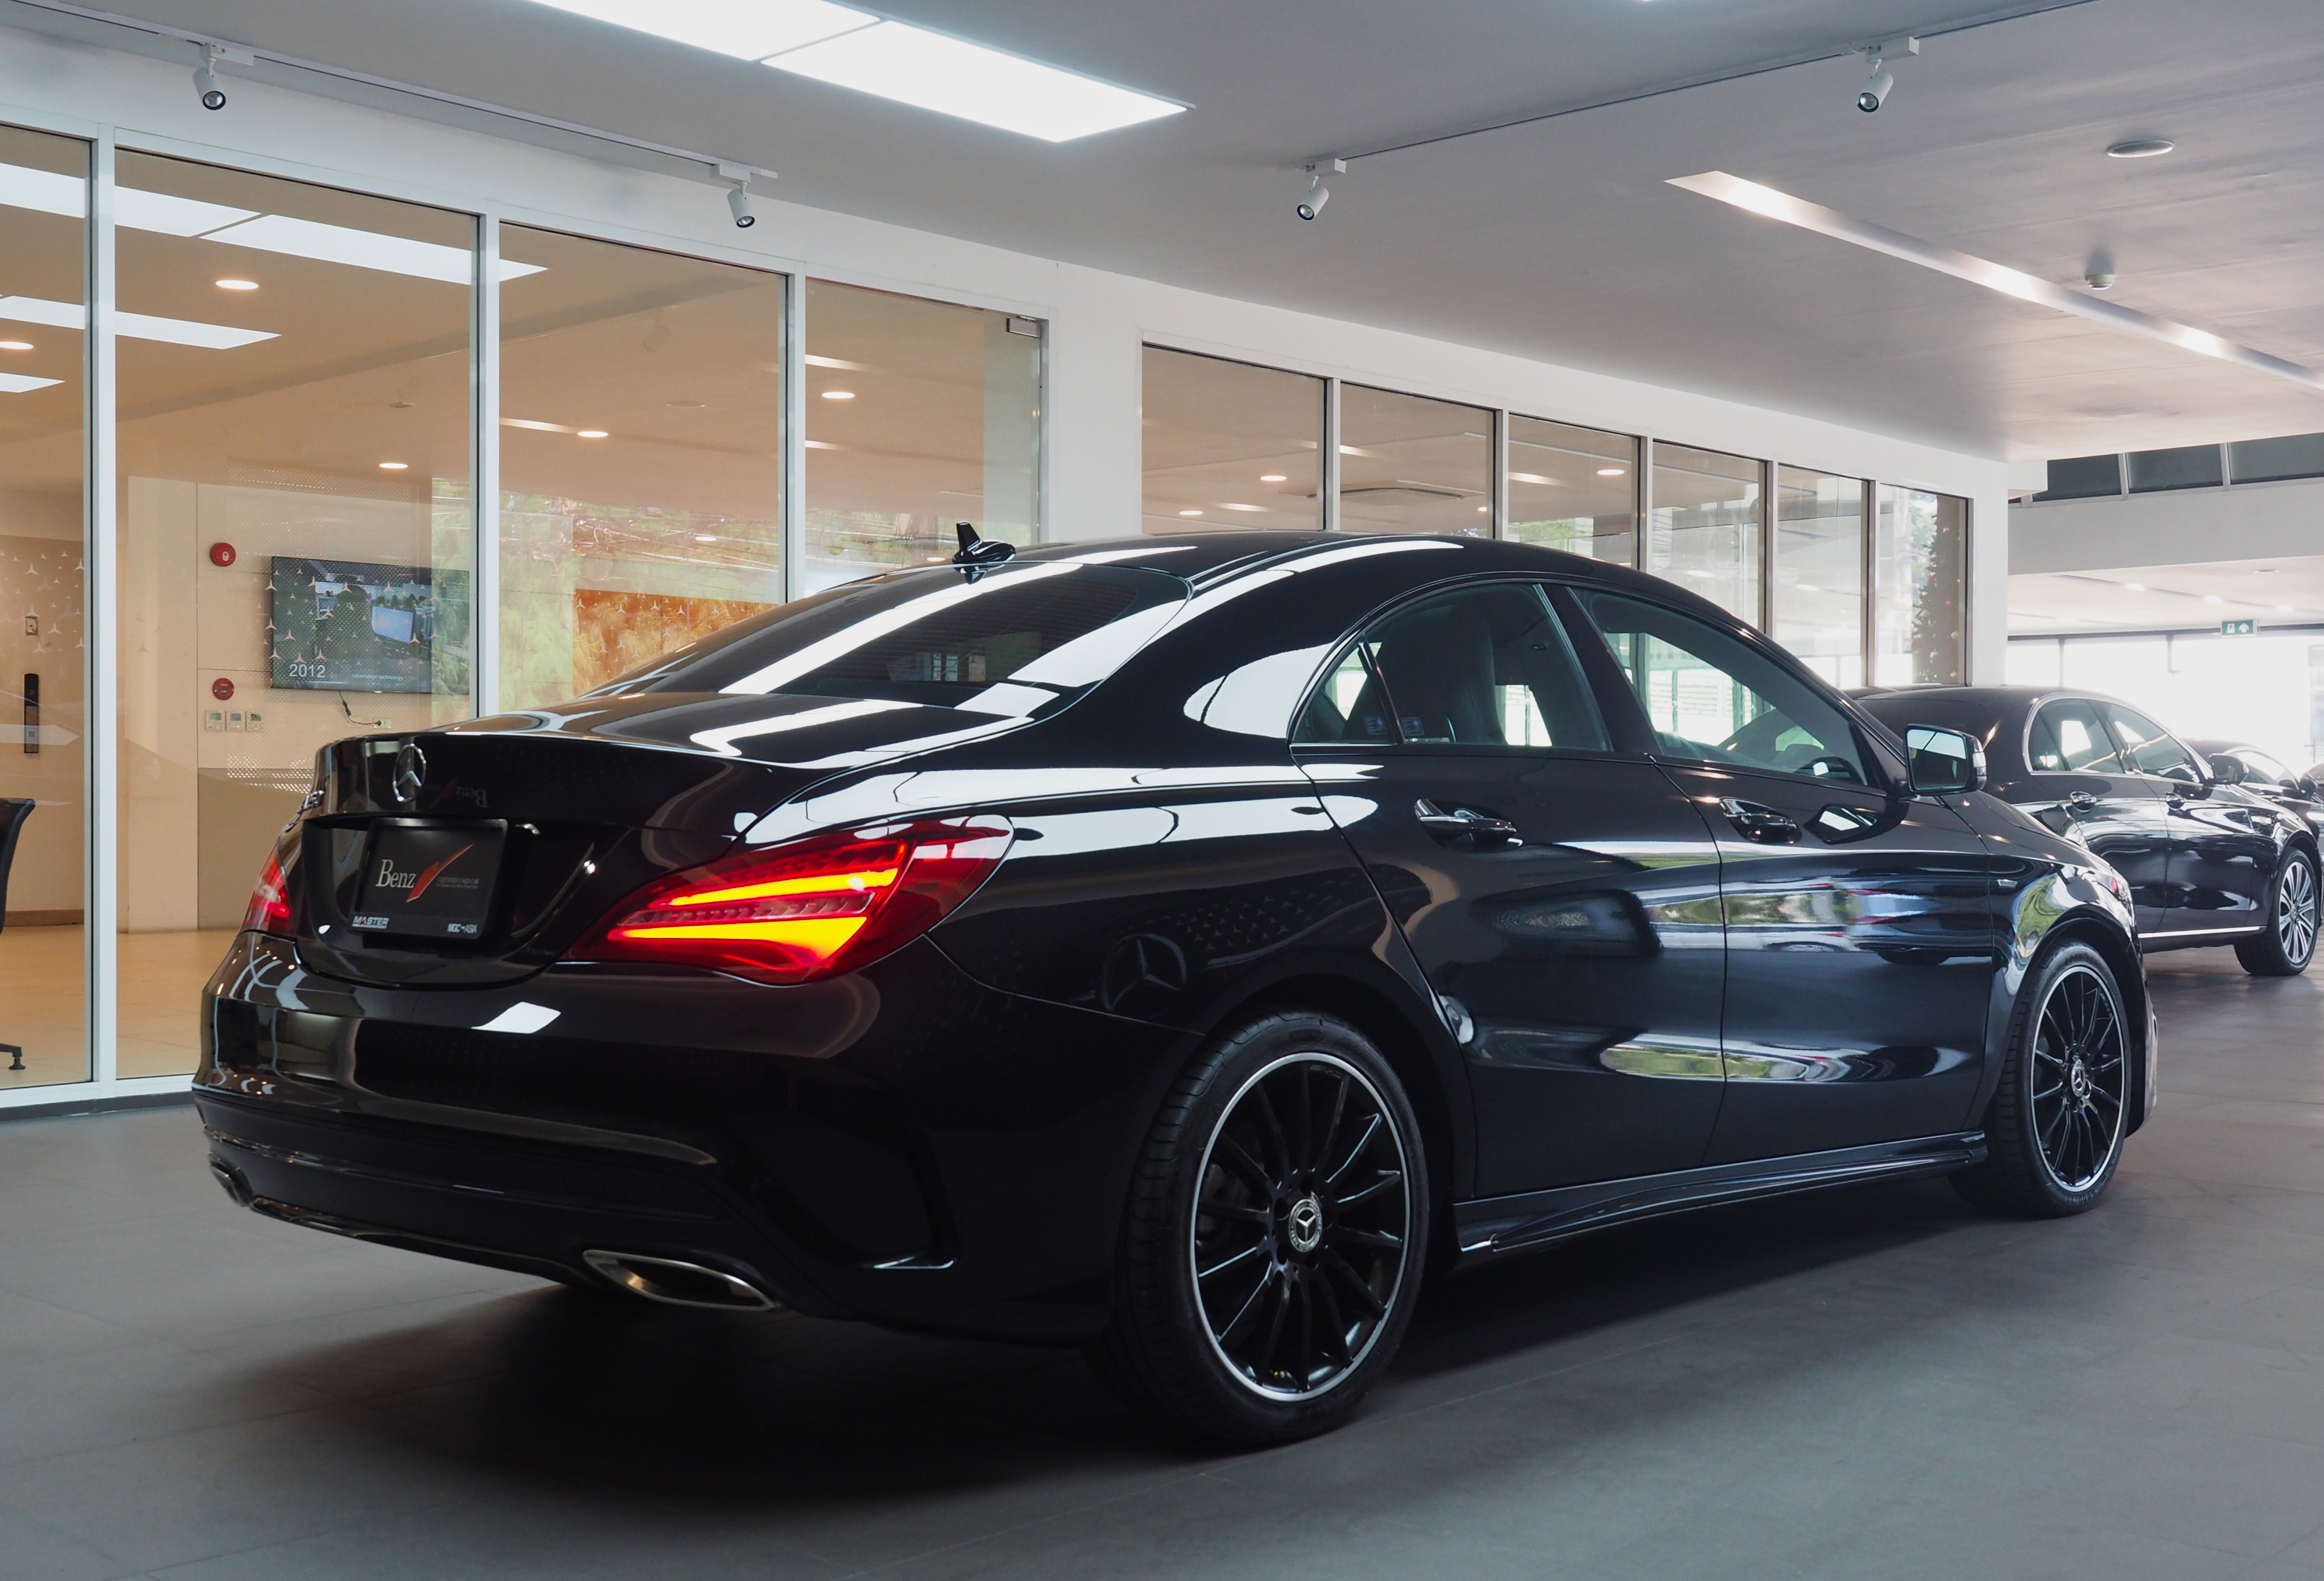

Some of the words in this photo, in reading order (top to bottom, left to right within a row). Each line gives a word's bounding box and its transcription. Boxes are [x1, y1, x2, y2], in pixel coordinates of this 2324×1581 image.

[289, 664, 326, 678] 2012
[375, 859, 416, 888] Benz
[352, 916, 389, 926] MASTER
